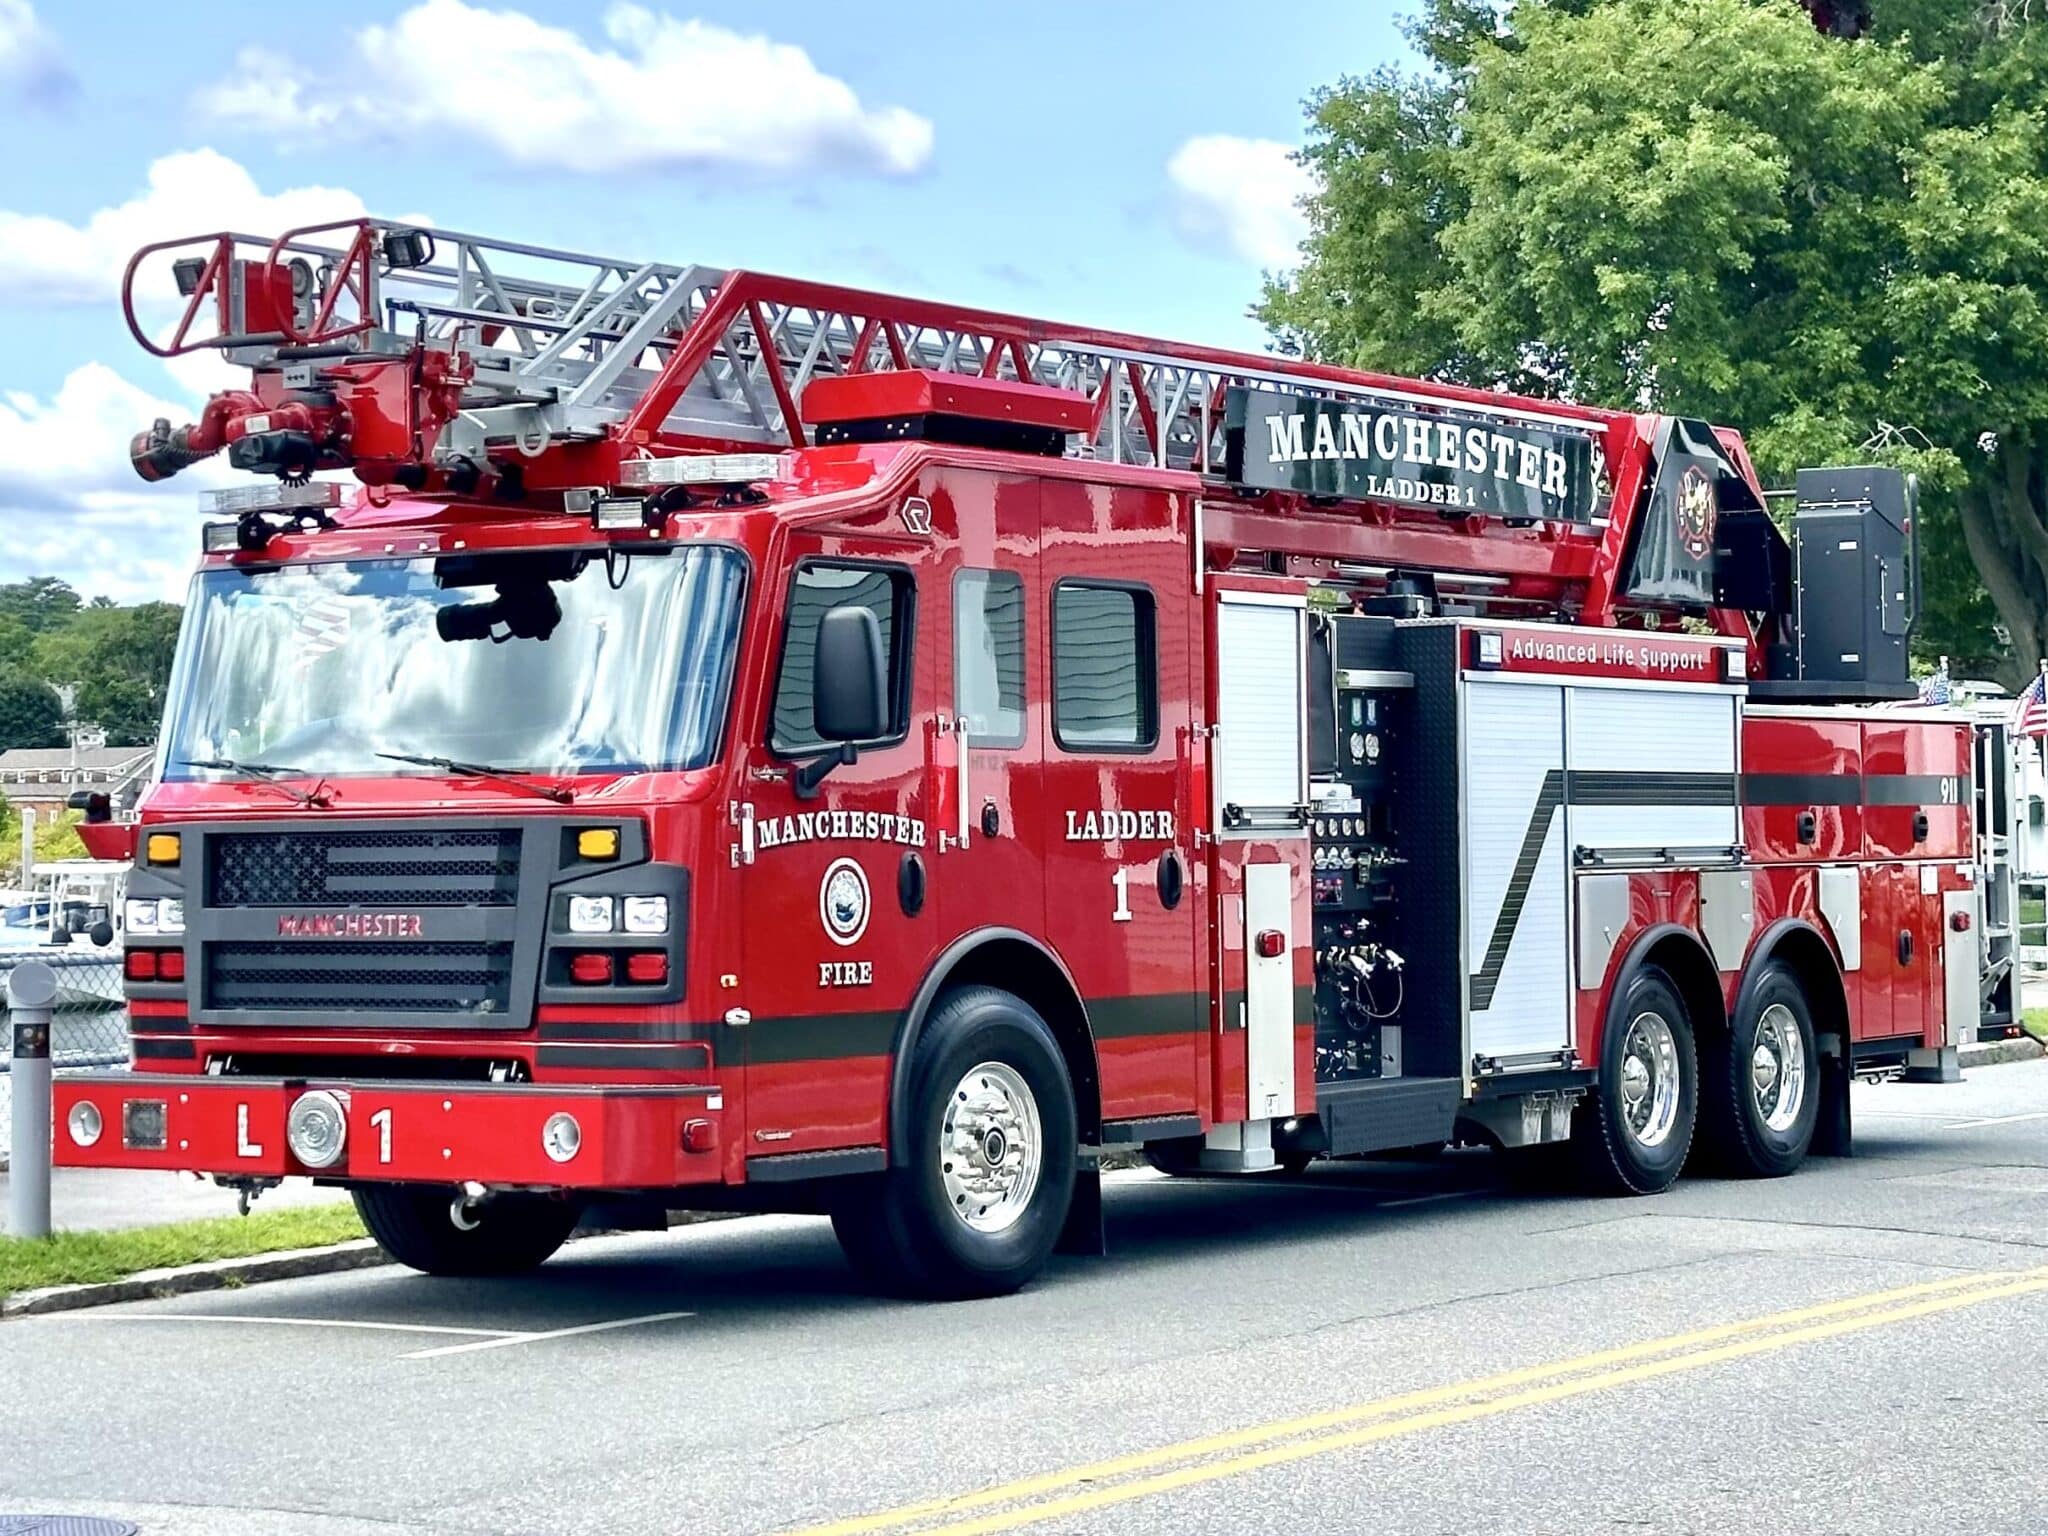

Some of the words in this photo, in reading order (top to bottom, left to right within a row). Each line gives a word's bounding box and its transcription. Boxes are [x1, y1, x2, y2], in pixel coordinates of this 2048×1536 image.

[1264, 414, 1569, 500] MANCHESTER
[1366, 474, 1460, 506] LADDER
[1464, 486, 1477, 507] 1
[1511, 637, 1596, 666] Advanced
[1603, 640, 1634, 667] Life
[1639, 645, 1704, 673] Support
[1940, 776, 1958, 804] 911
[757, 810, 927, 849] MANCHESTER
[1065, 809, 1175, 841] LADDER
[1111, 868, 1132, 922] 1
[278, 913, 424, 939] MANCHESTER
[818, 961, 873, 988] FIRE
[237, 1103, 263, 1158] L
[370, 1107, 393, 1164] 1
